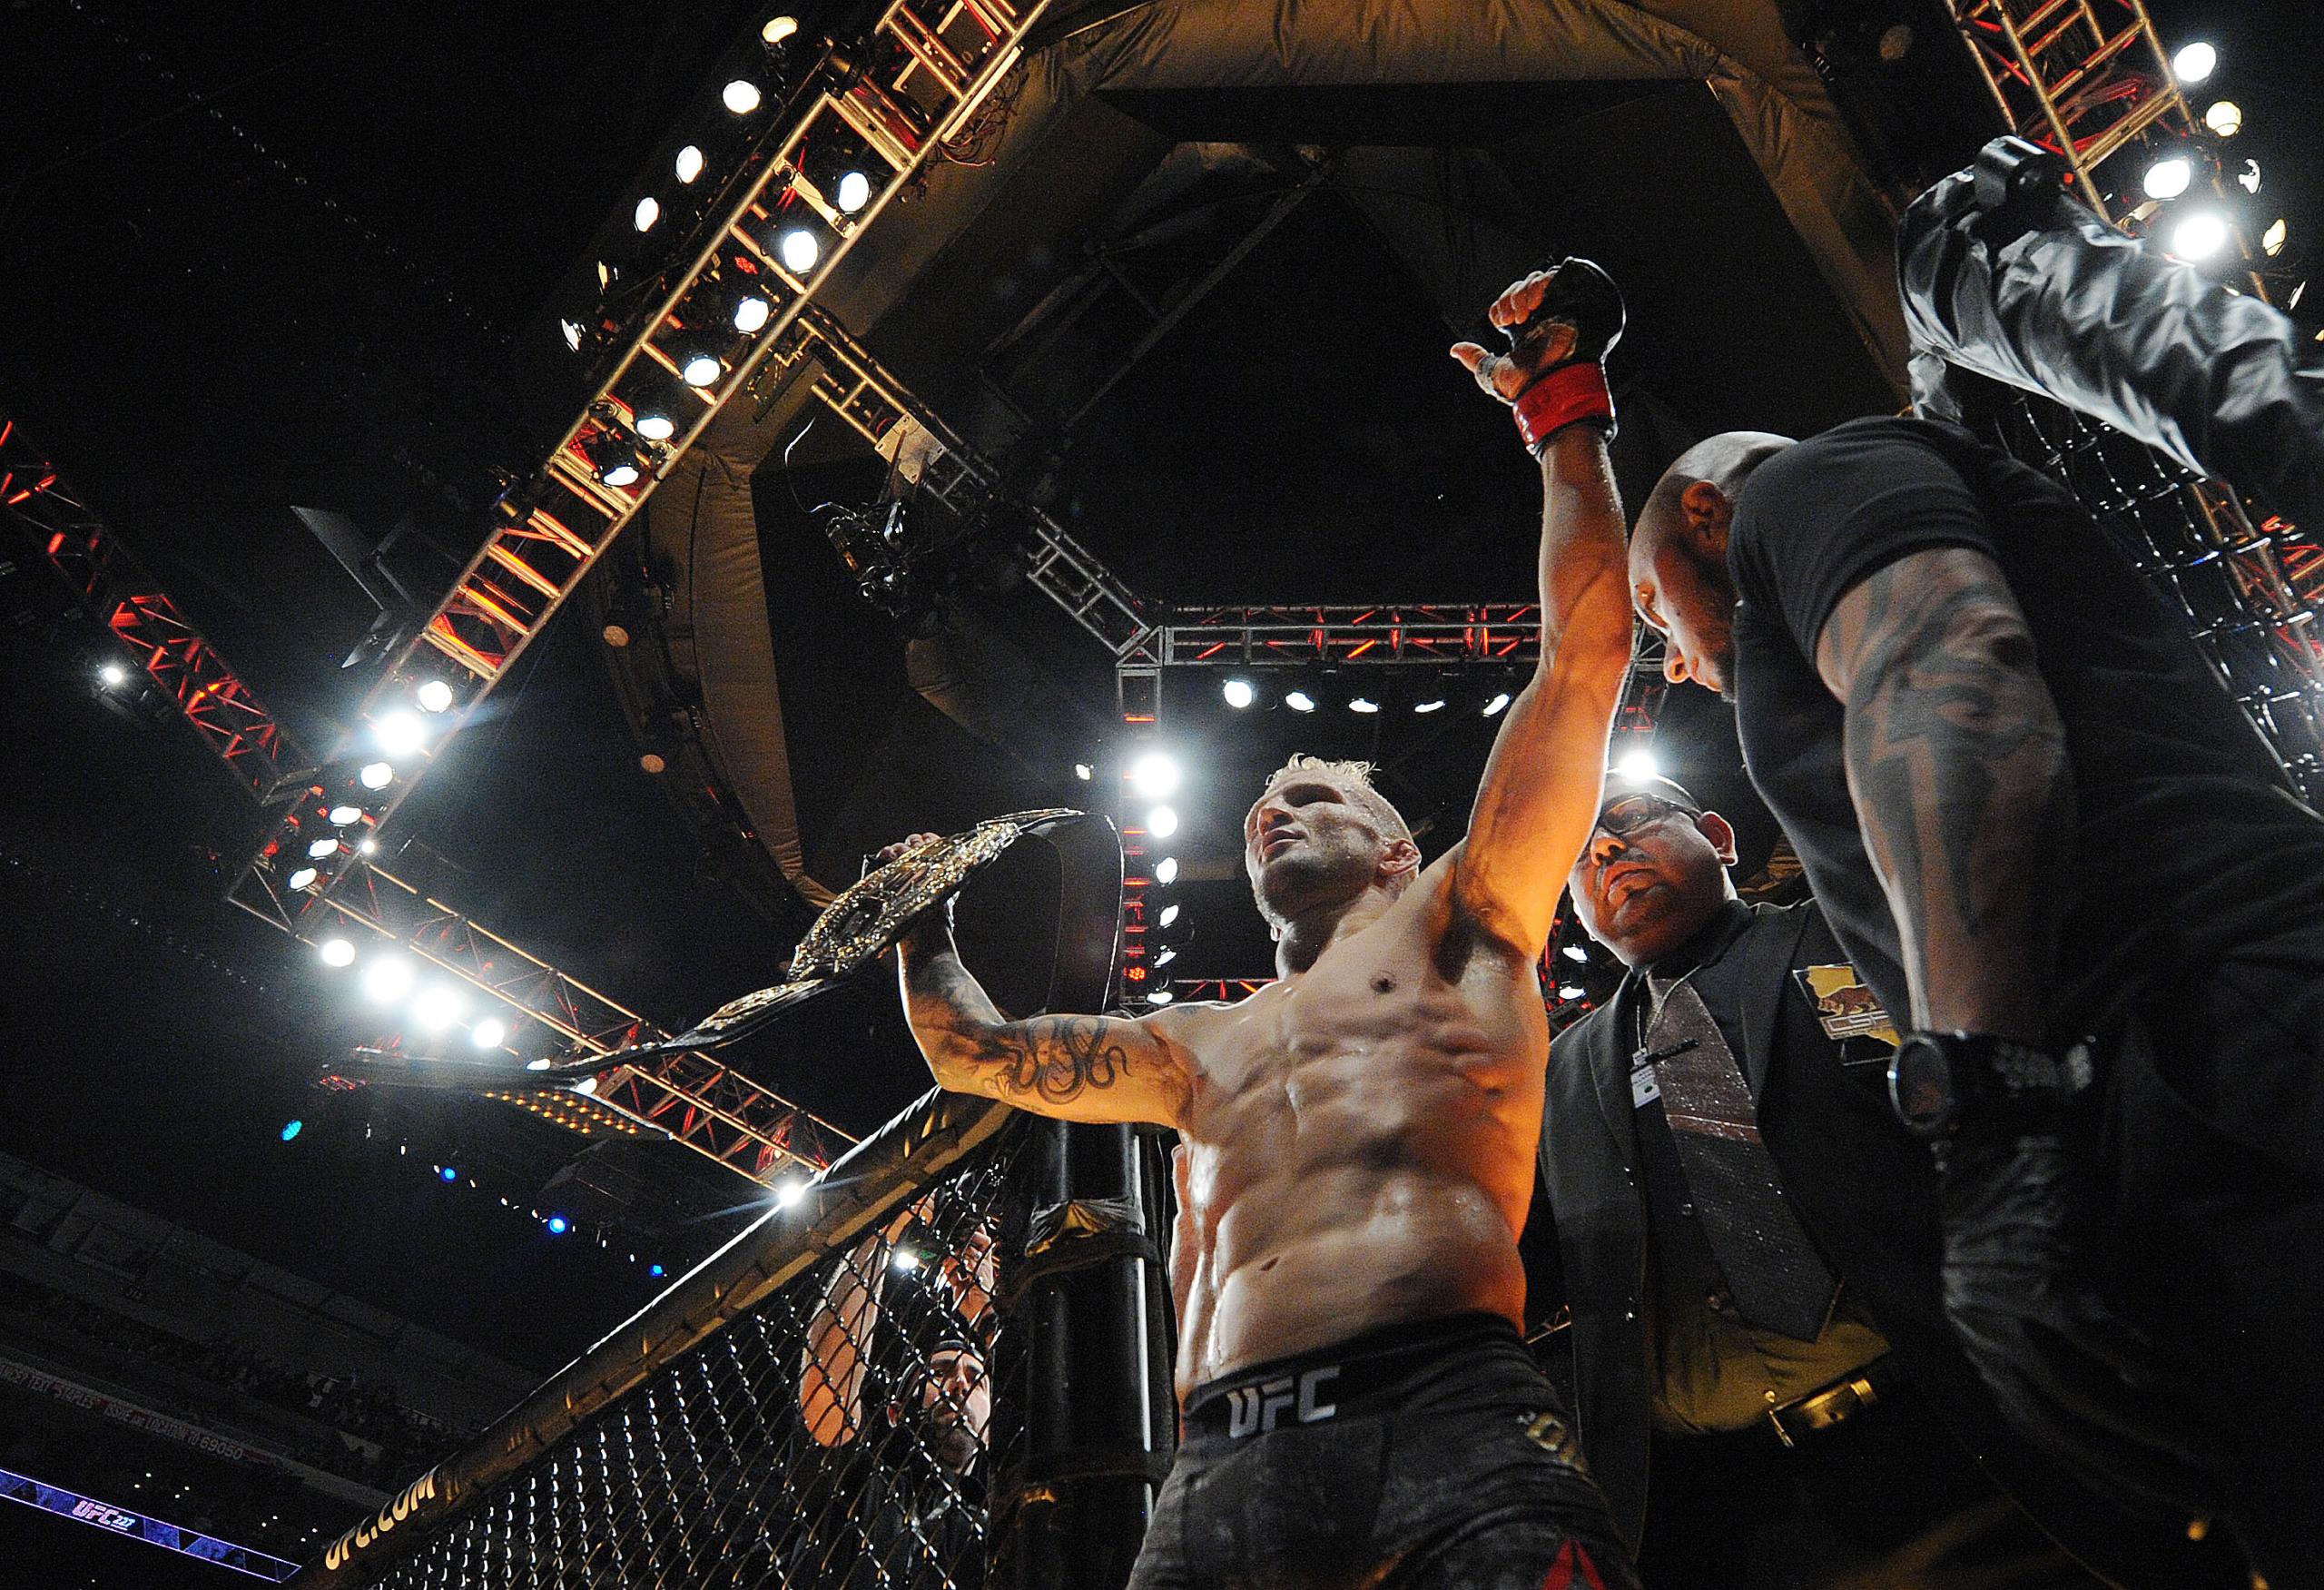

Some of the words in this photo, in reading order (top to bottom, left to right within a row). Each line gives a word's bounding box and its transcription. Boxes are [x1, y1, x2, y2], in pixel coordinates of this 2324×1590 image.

[1226, 1365, 1341, 1439] UFC
[200, 1437, 244, 1460] 69050
[72, 1499, 120, 1526] UFC
